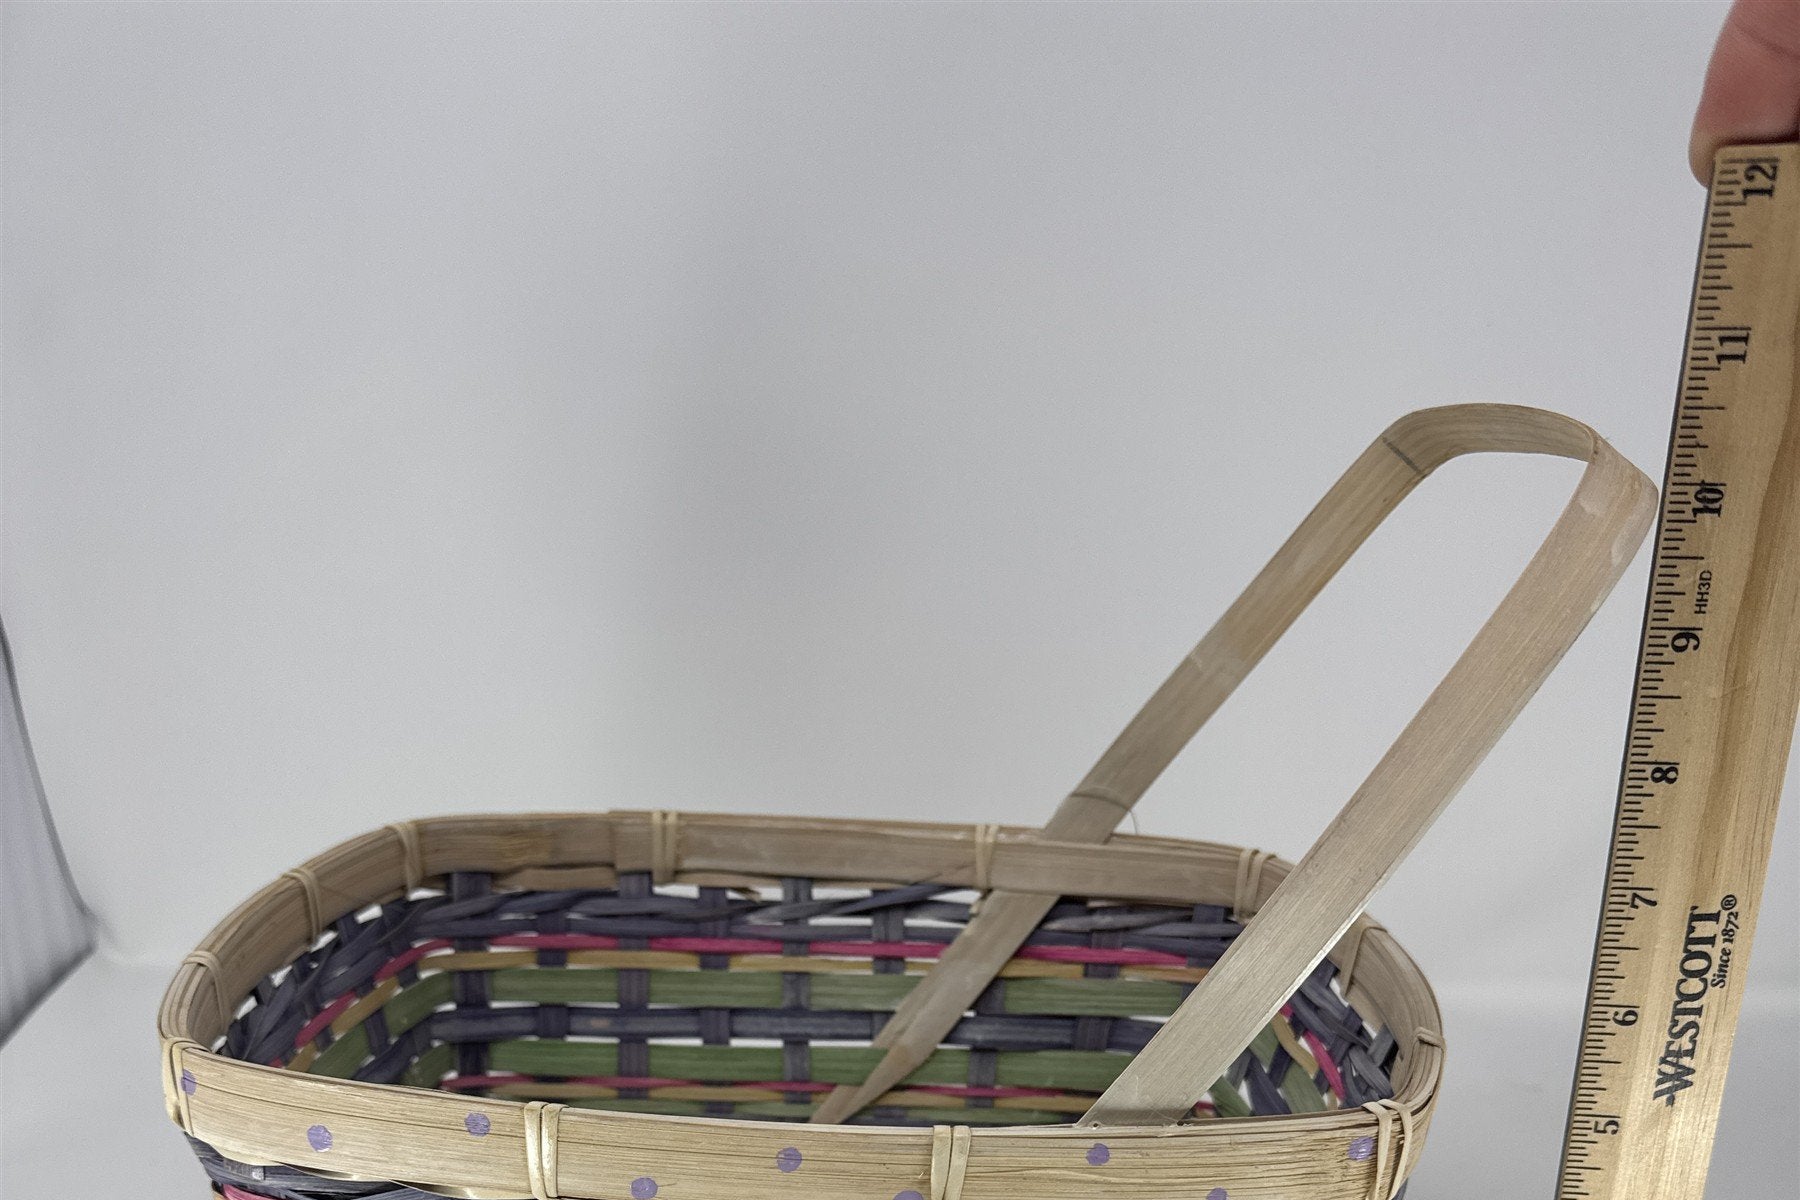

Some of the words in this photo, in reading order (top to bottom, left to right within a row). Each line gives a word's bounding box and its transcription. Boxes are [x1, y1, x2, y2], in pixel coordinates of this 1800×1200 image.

[1742, 165, 1778, 198] 12
[1716, 332, 1749, 364] 11
[1692, 486, 1724, 518] 10
[1694, 570, 1712, 614] HH3D
[1671, 632, 1700, 653] 9
[1651, 766, 1679, 784] 8
[1630, 893, 1657, 909] 7
[1720, 911, 1739, 945] 1872
[1711, 947, 1732, 988] Since
[1613, 1010, 1639, 1027] 6
[1653, 905, 1722, 1107] WESTCOTT
[1594, 1120, 1619, 1135] 5
